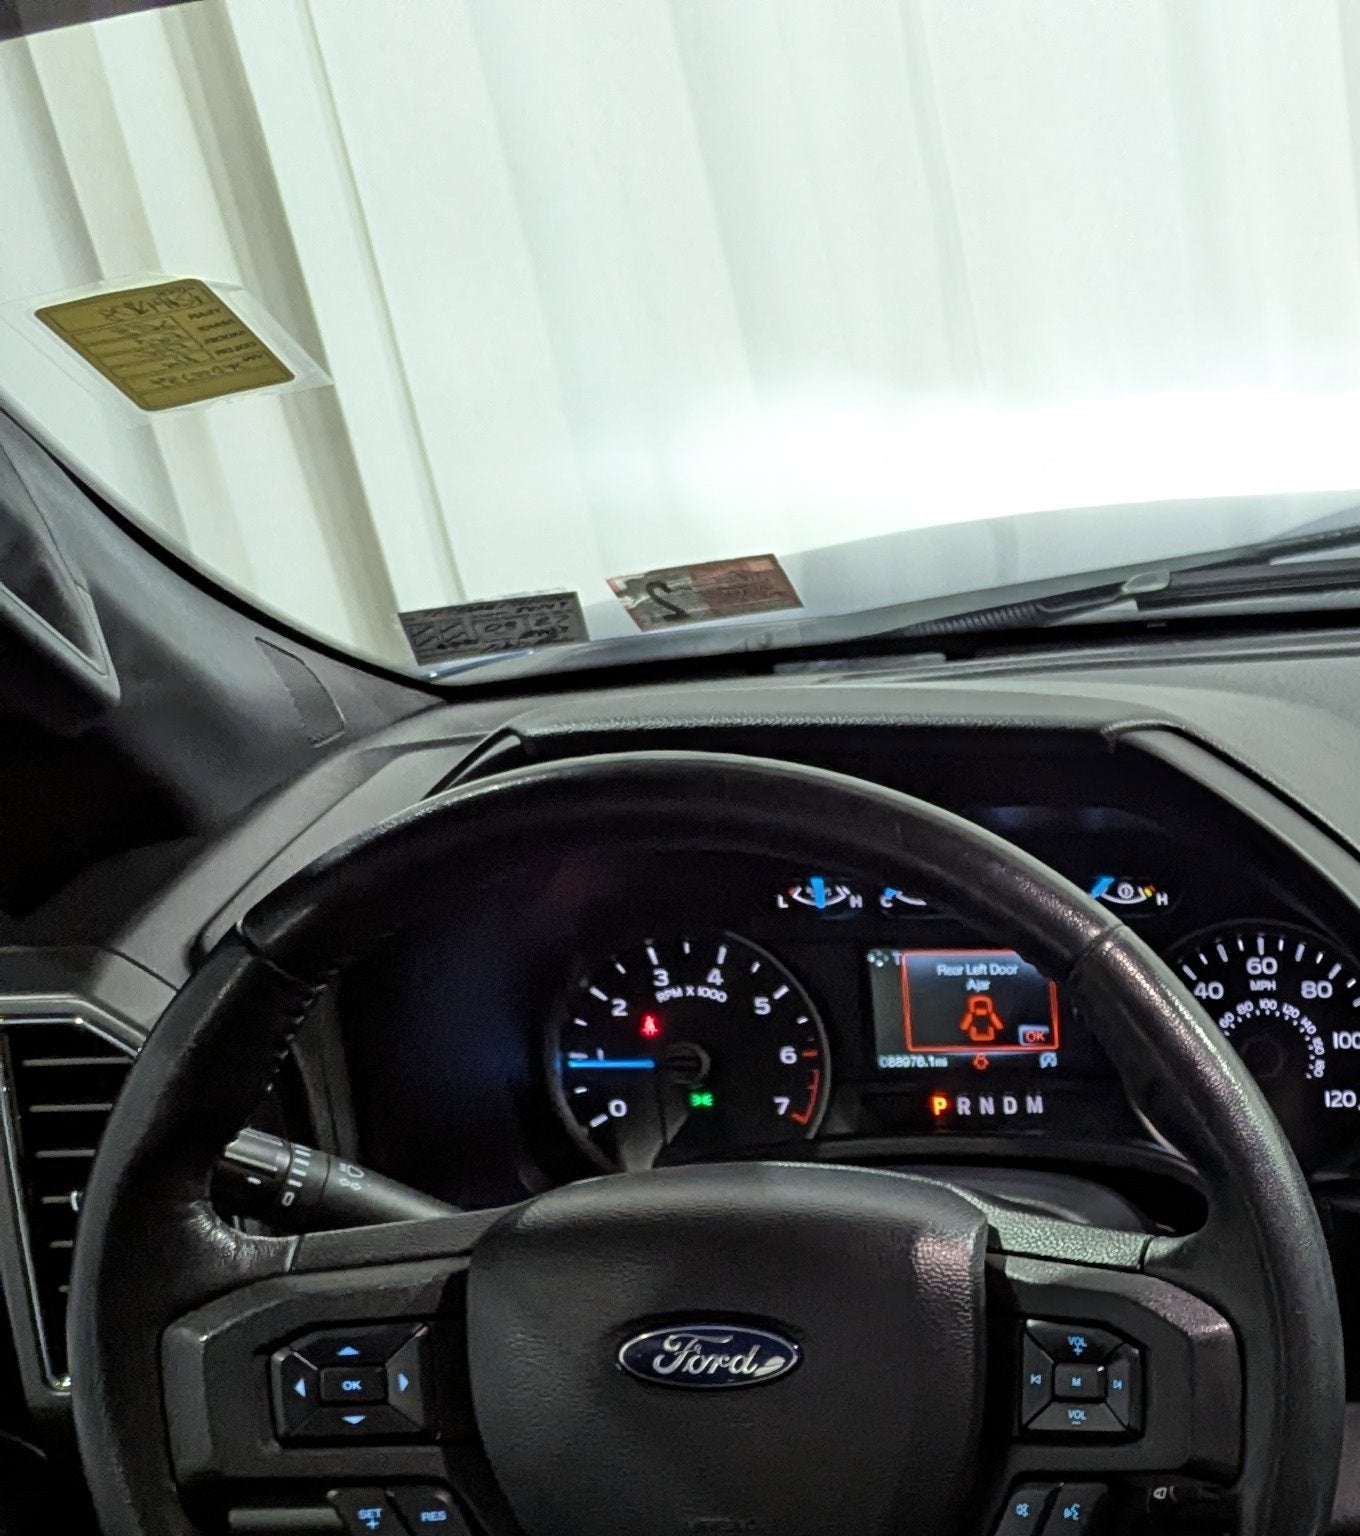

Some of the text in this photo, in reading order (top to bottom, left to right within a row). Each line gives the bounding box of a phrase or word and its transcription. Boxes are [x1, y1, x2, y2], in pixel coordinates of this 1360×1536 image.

[850, 894, 862, 909] H
[880, 896, 894, 908] C
[1155, 893, 1168, 907] H
[936, 964, 1018, 976] Rear Left Door
[1246, 956, 1278, 976] 60
[653, 968, 670, 987] 3
[706, 968, 724, 986] 4
[965, 978, 991, 992] Ajar
[1250, 979, 1277, 992] MPH
[655, 985, 728, 1003] RPM X 1000
[1194, 981, 1224, 1000] 40
[1301, 980, 1333, 998] 80
[611, 998, 628, 1017] 2
[754, 996, 771, 1016] 5
[1236, 1000, 1254, 1016] 80
[1258, 998, 1278, 1010] 100
[1282, 1002, 1300, 1019] 120
[1218, 1011, 1234, 1029] 60
[1300, 1016, 1317, 1035] 140
[1025, 1032, 1046, 1042] OK
[780, 1046, 798, 1065] 6
[773, 1096, 790, 1116] 7
[933, 1094, 1044, 1116] P R N D M
[1324, 1089, 1357, 1108] 120
[608, 1099, 628, 1118] 0
[1067, 1336, 1088, 1348] VOL
[652, 1333, 785, 1377] Ford
[342, 1380, 362, 1390] OK
[1068, 1408, 1087, 1420] VOL
[358, 1508, 382, 1520] SET
[420, 1510, 448, 1522] RES
